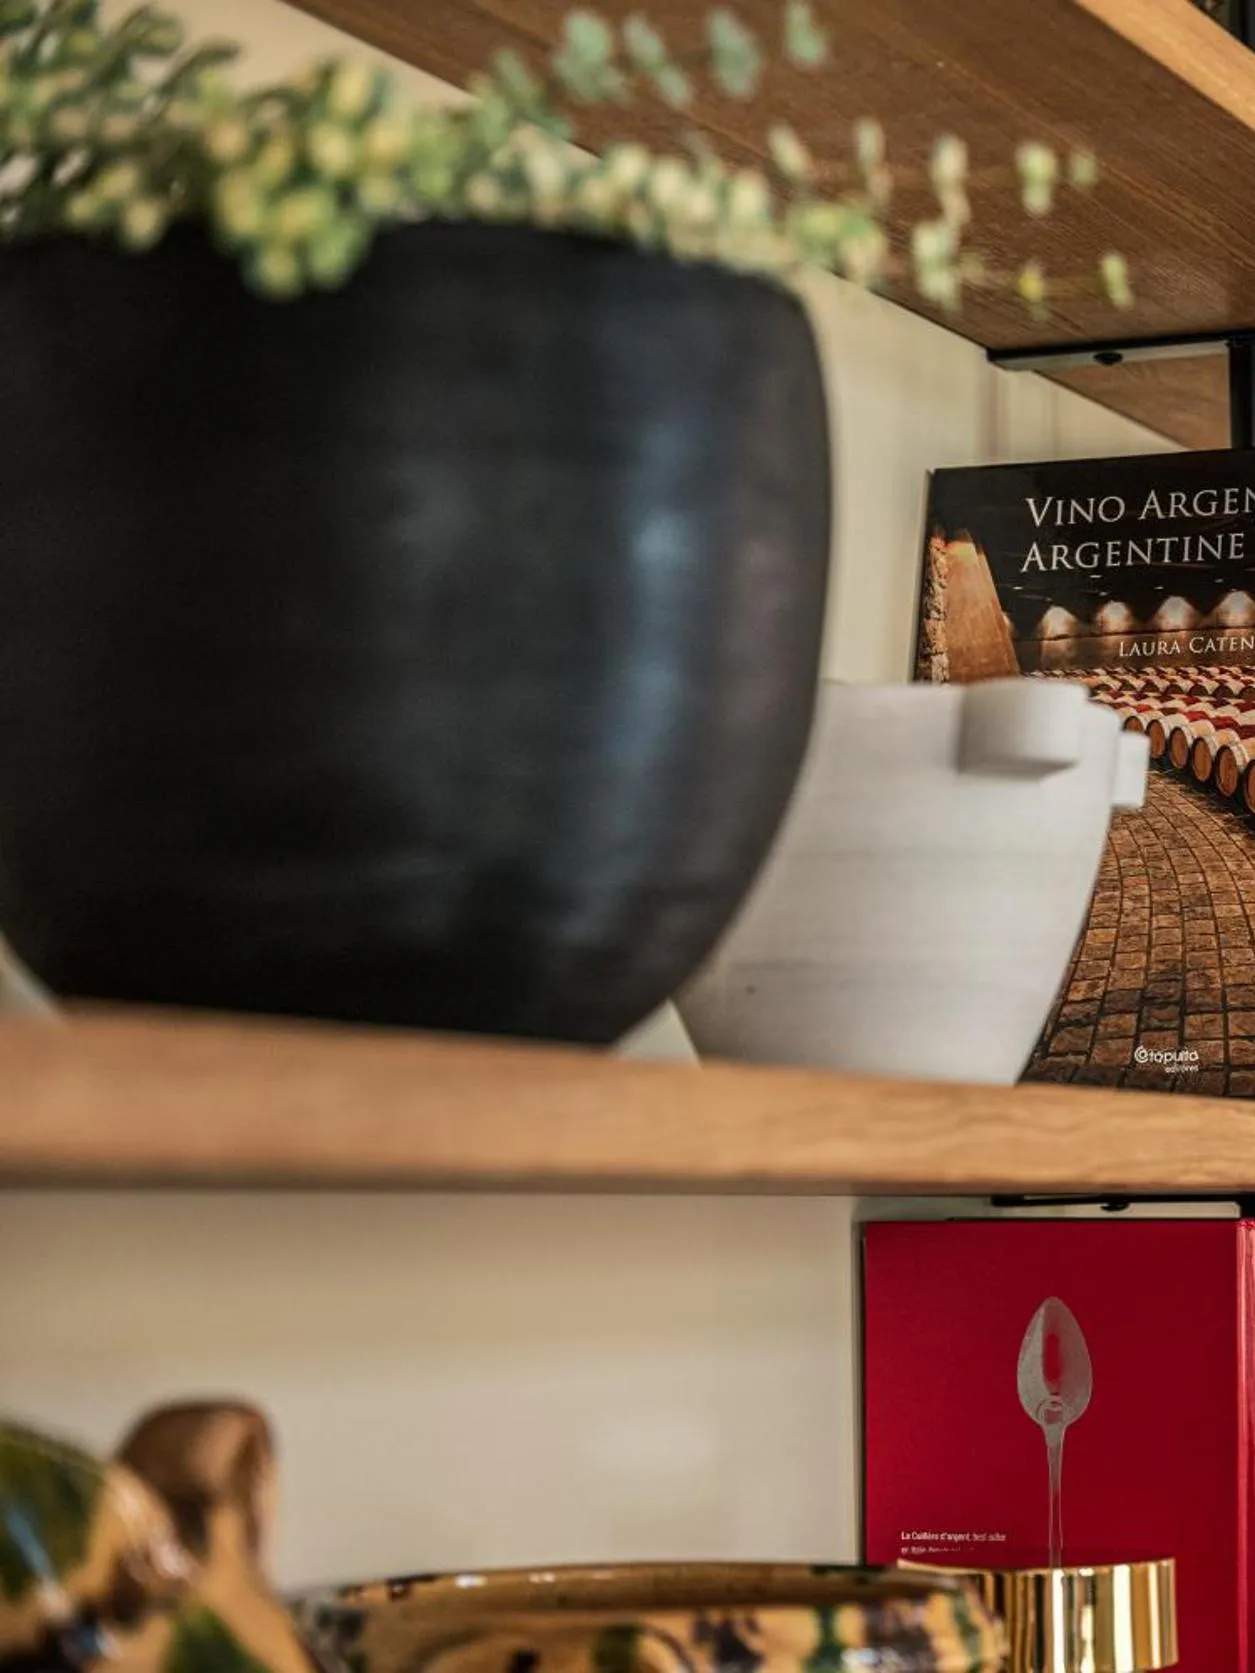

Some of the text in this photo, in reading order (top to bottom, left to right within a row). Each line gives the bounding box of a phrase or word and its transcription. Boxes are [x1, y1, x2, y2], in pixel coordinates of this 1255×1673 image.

[1025, 496, 1125, 527] VINO
[1020, 532, 1245, 573] ARGENTINE
[1119, 641, 1181, 657] LAURA
